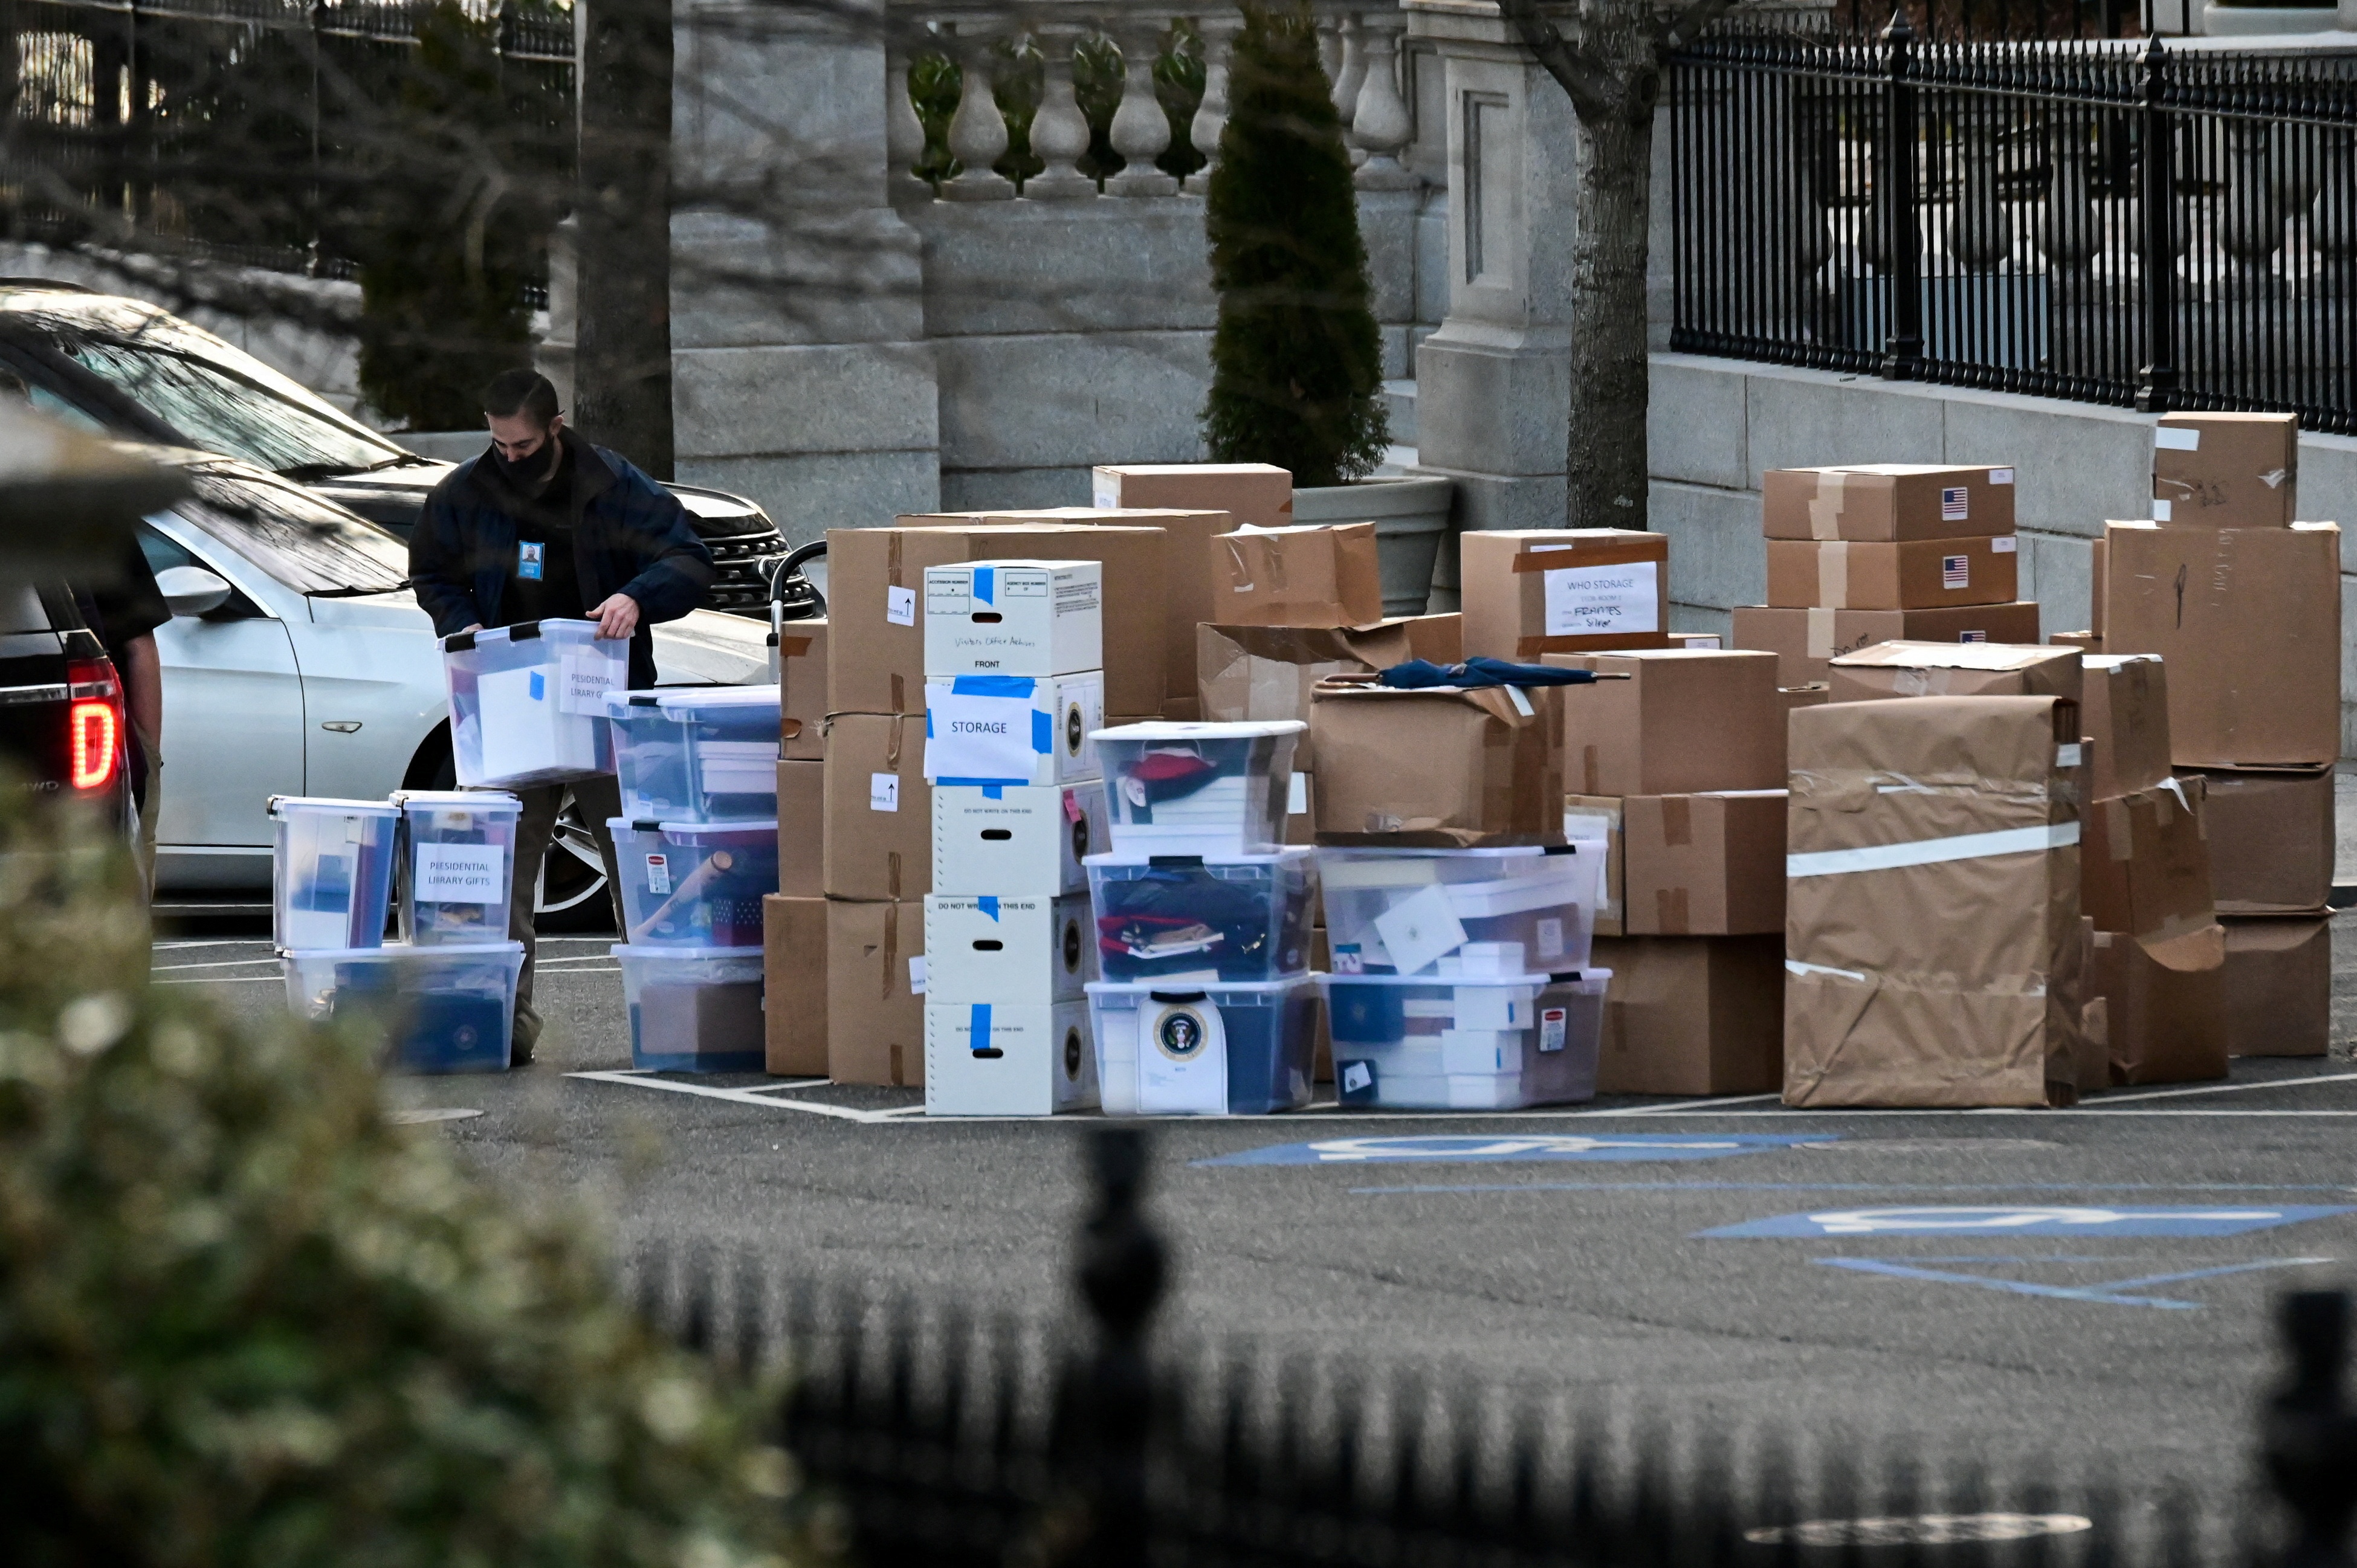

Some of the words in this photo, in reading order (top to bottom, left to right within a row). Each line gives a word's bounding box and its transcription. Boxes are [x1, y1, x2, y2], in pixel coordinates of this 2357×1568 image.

[1568, 580, 1591, 590] WHO
[1594, 579, 1634, 589] STORAGE
[572, 673, 615, 685] PESIDENTIAL
[571, 688, 595, 697] LIRARY
[952, 721, 1007, 734] STORAGE
[465, 876, 490, 886] GIFTS
